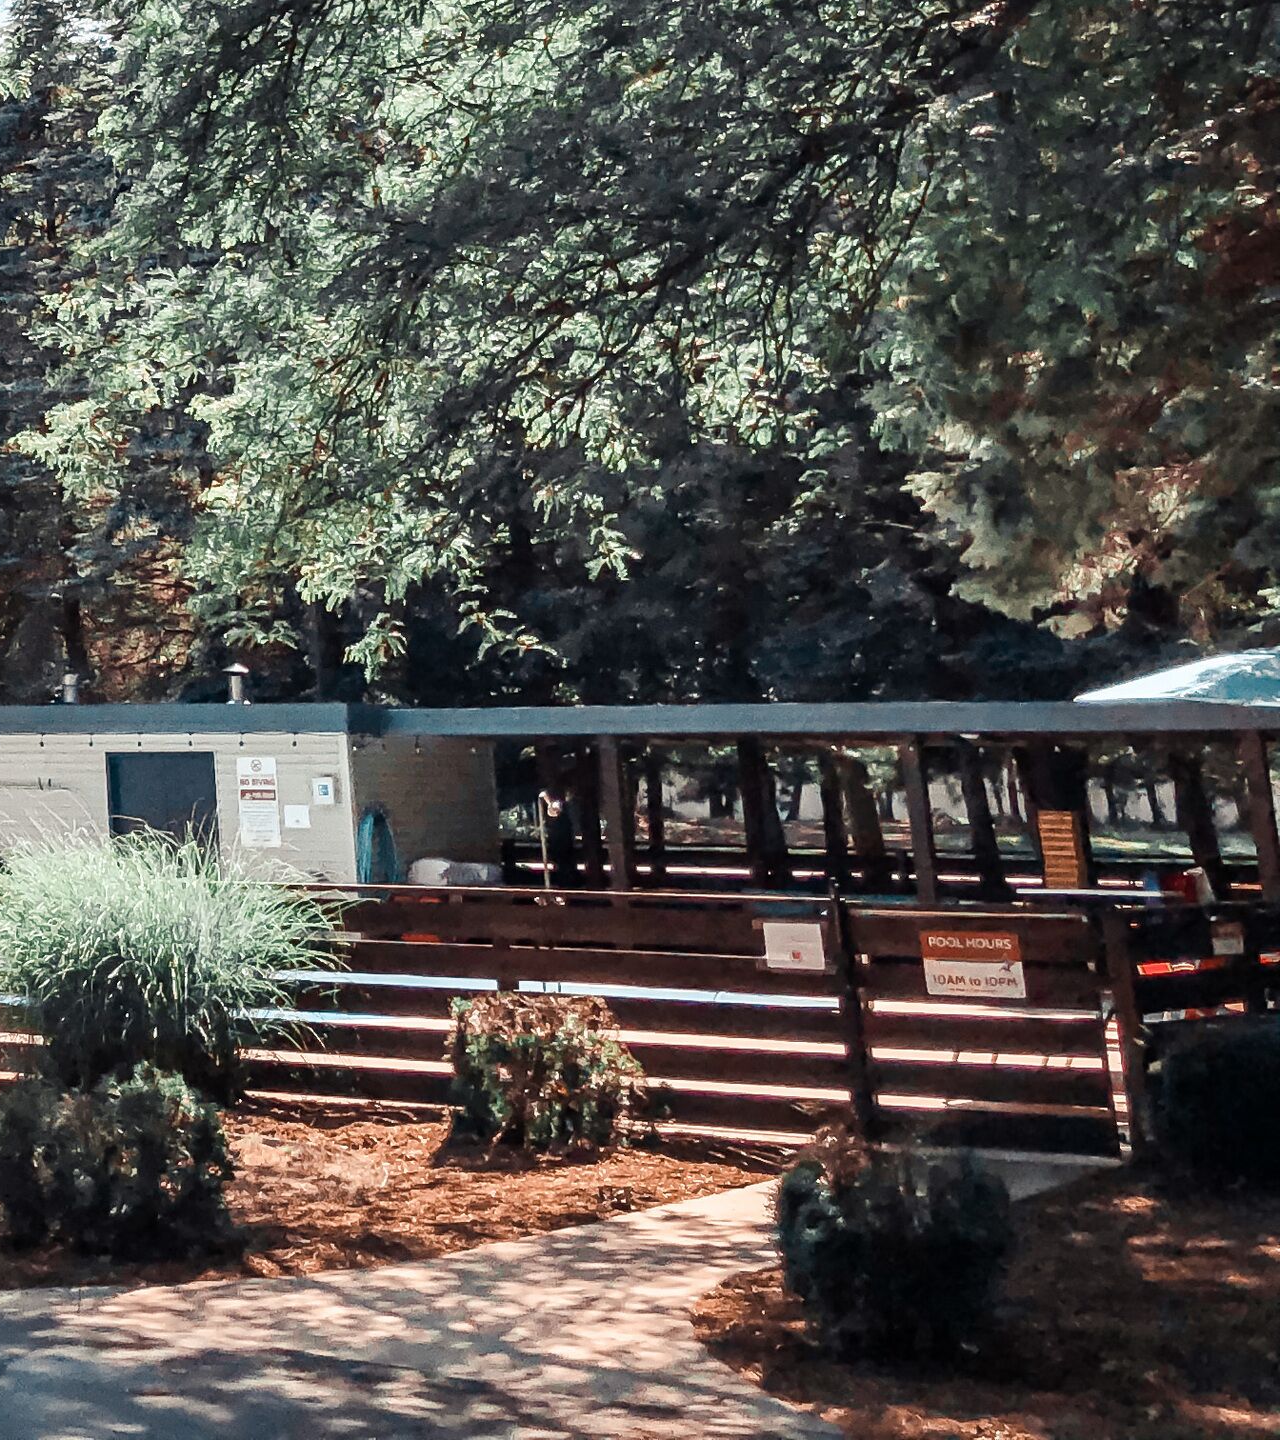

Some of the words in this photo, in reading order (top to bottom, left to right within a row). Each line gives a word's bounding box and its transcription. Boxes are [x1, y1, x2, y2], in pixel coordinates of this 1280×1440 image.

[928, 936, 964, 949] POOL
[966, 938, 1012, 950] HOURS
[933, 974, 966, 985] 10AM
[985, 976, 1019, 987] 10PM
